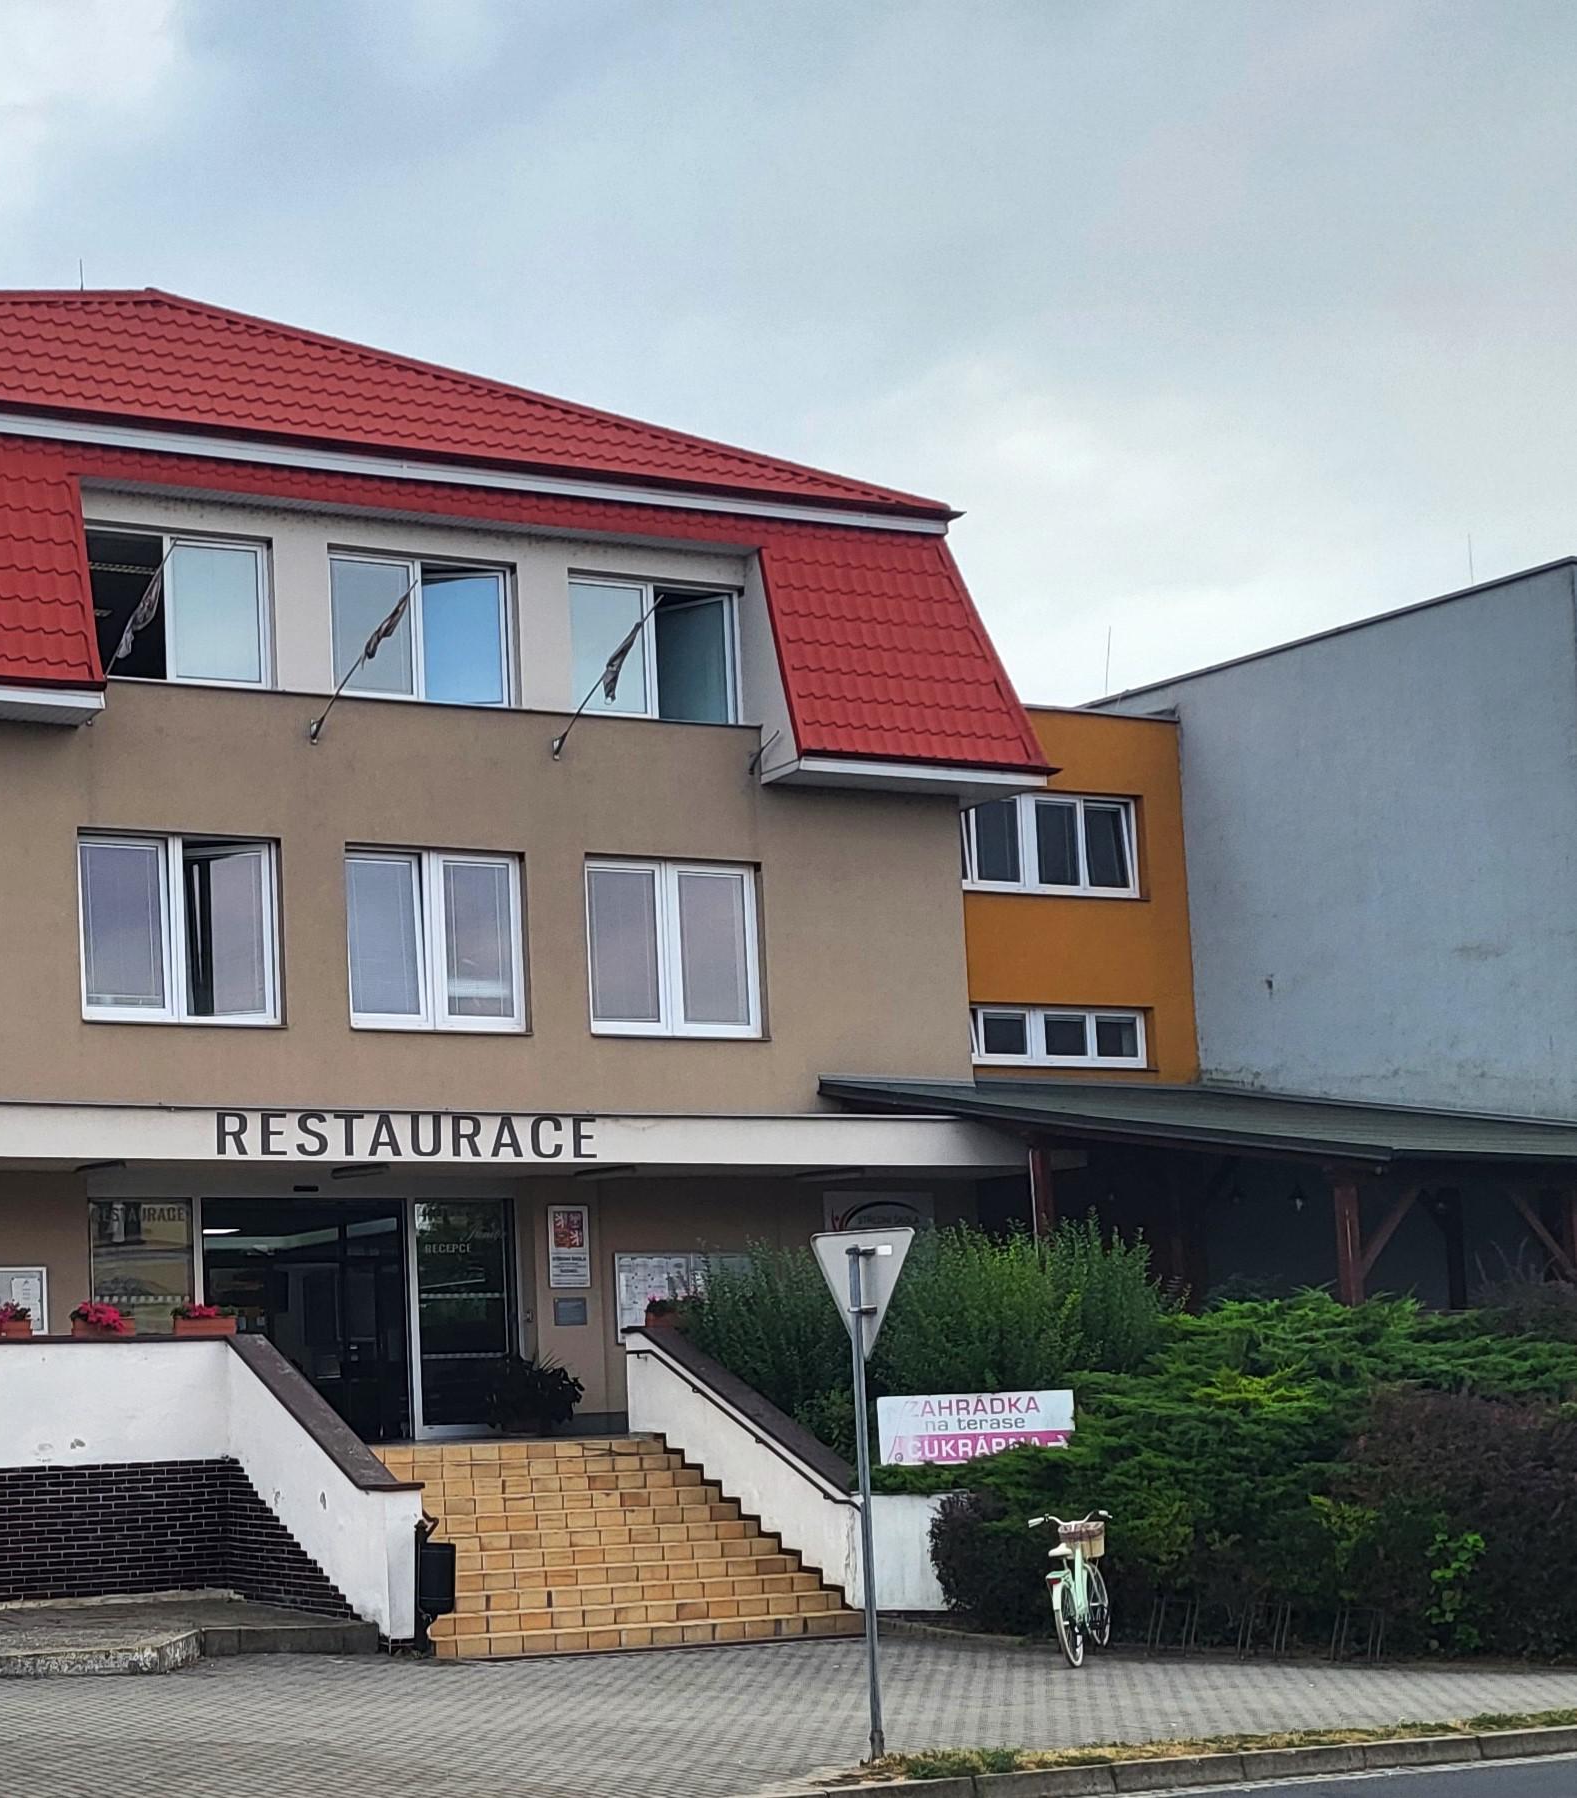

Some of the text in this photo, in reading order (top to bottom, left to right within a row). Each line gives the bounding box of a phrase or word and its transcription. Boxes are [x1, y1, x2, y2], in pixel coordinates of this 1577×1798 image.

[216, 1111, 598, 1159] RESTAURACE
[424, 1242, 472, 1254] RECEPCE
[909, 1395, 1041, 1418] ZAHRÁDKA
[924, 1416, 1026, 1432] na terase
